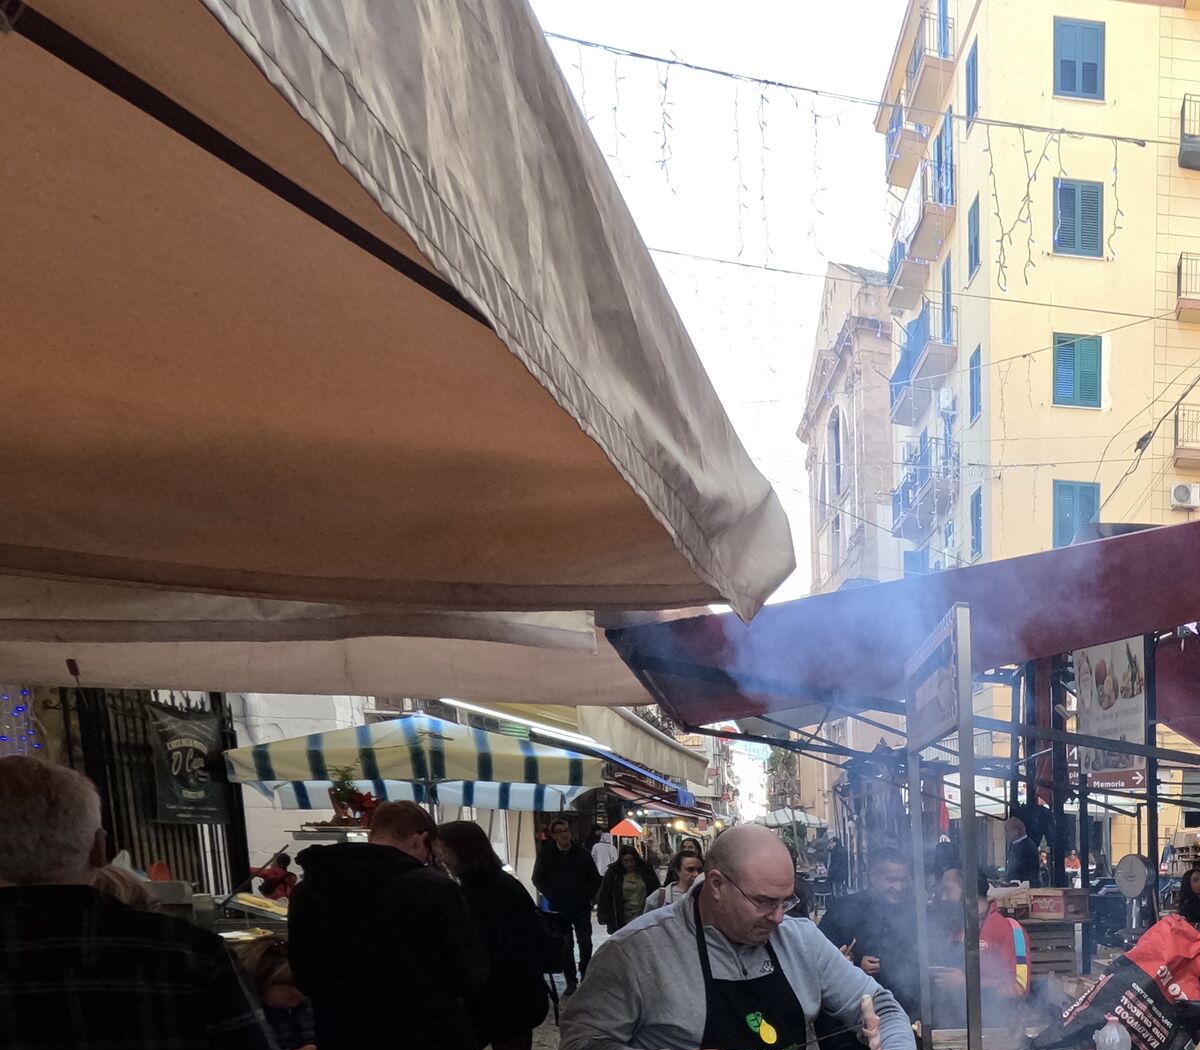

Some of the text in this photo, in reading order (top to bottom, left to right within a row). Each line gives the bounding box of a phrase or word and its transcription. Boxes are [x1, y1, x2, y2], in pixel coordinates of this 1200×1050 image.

[1093, 780, 1126, 788] Memoria
[1157, 965, 1173, 987] KG
[1120, 995, 1153, 1028] CHARCOAL
[1114, 1005, 1160, 1050] HARDWOOD
